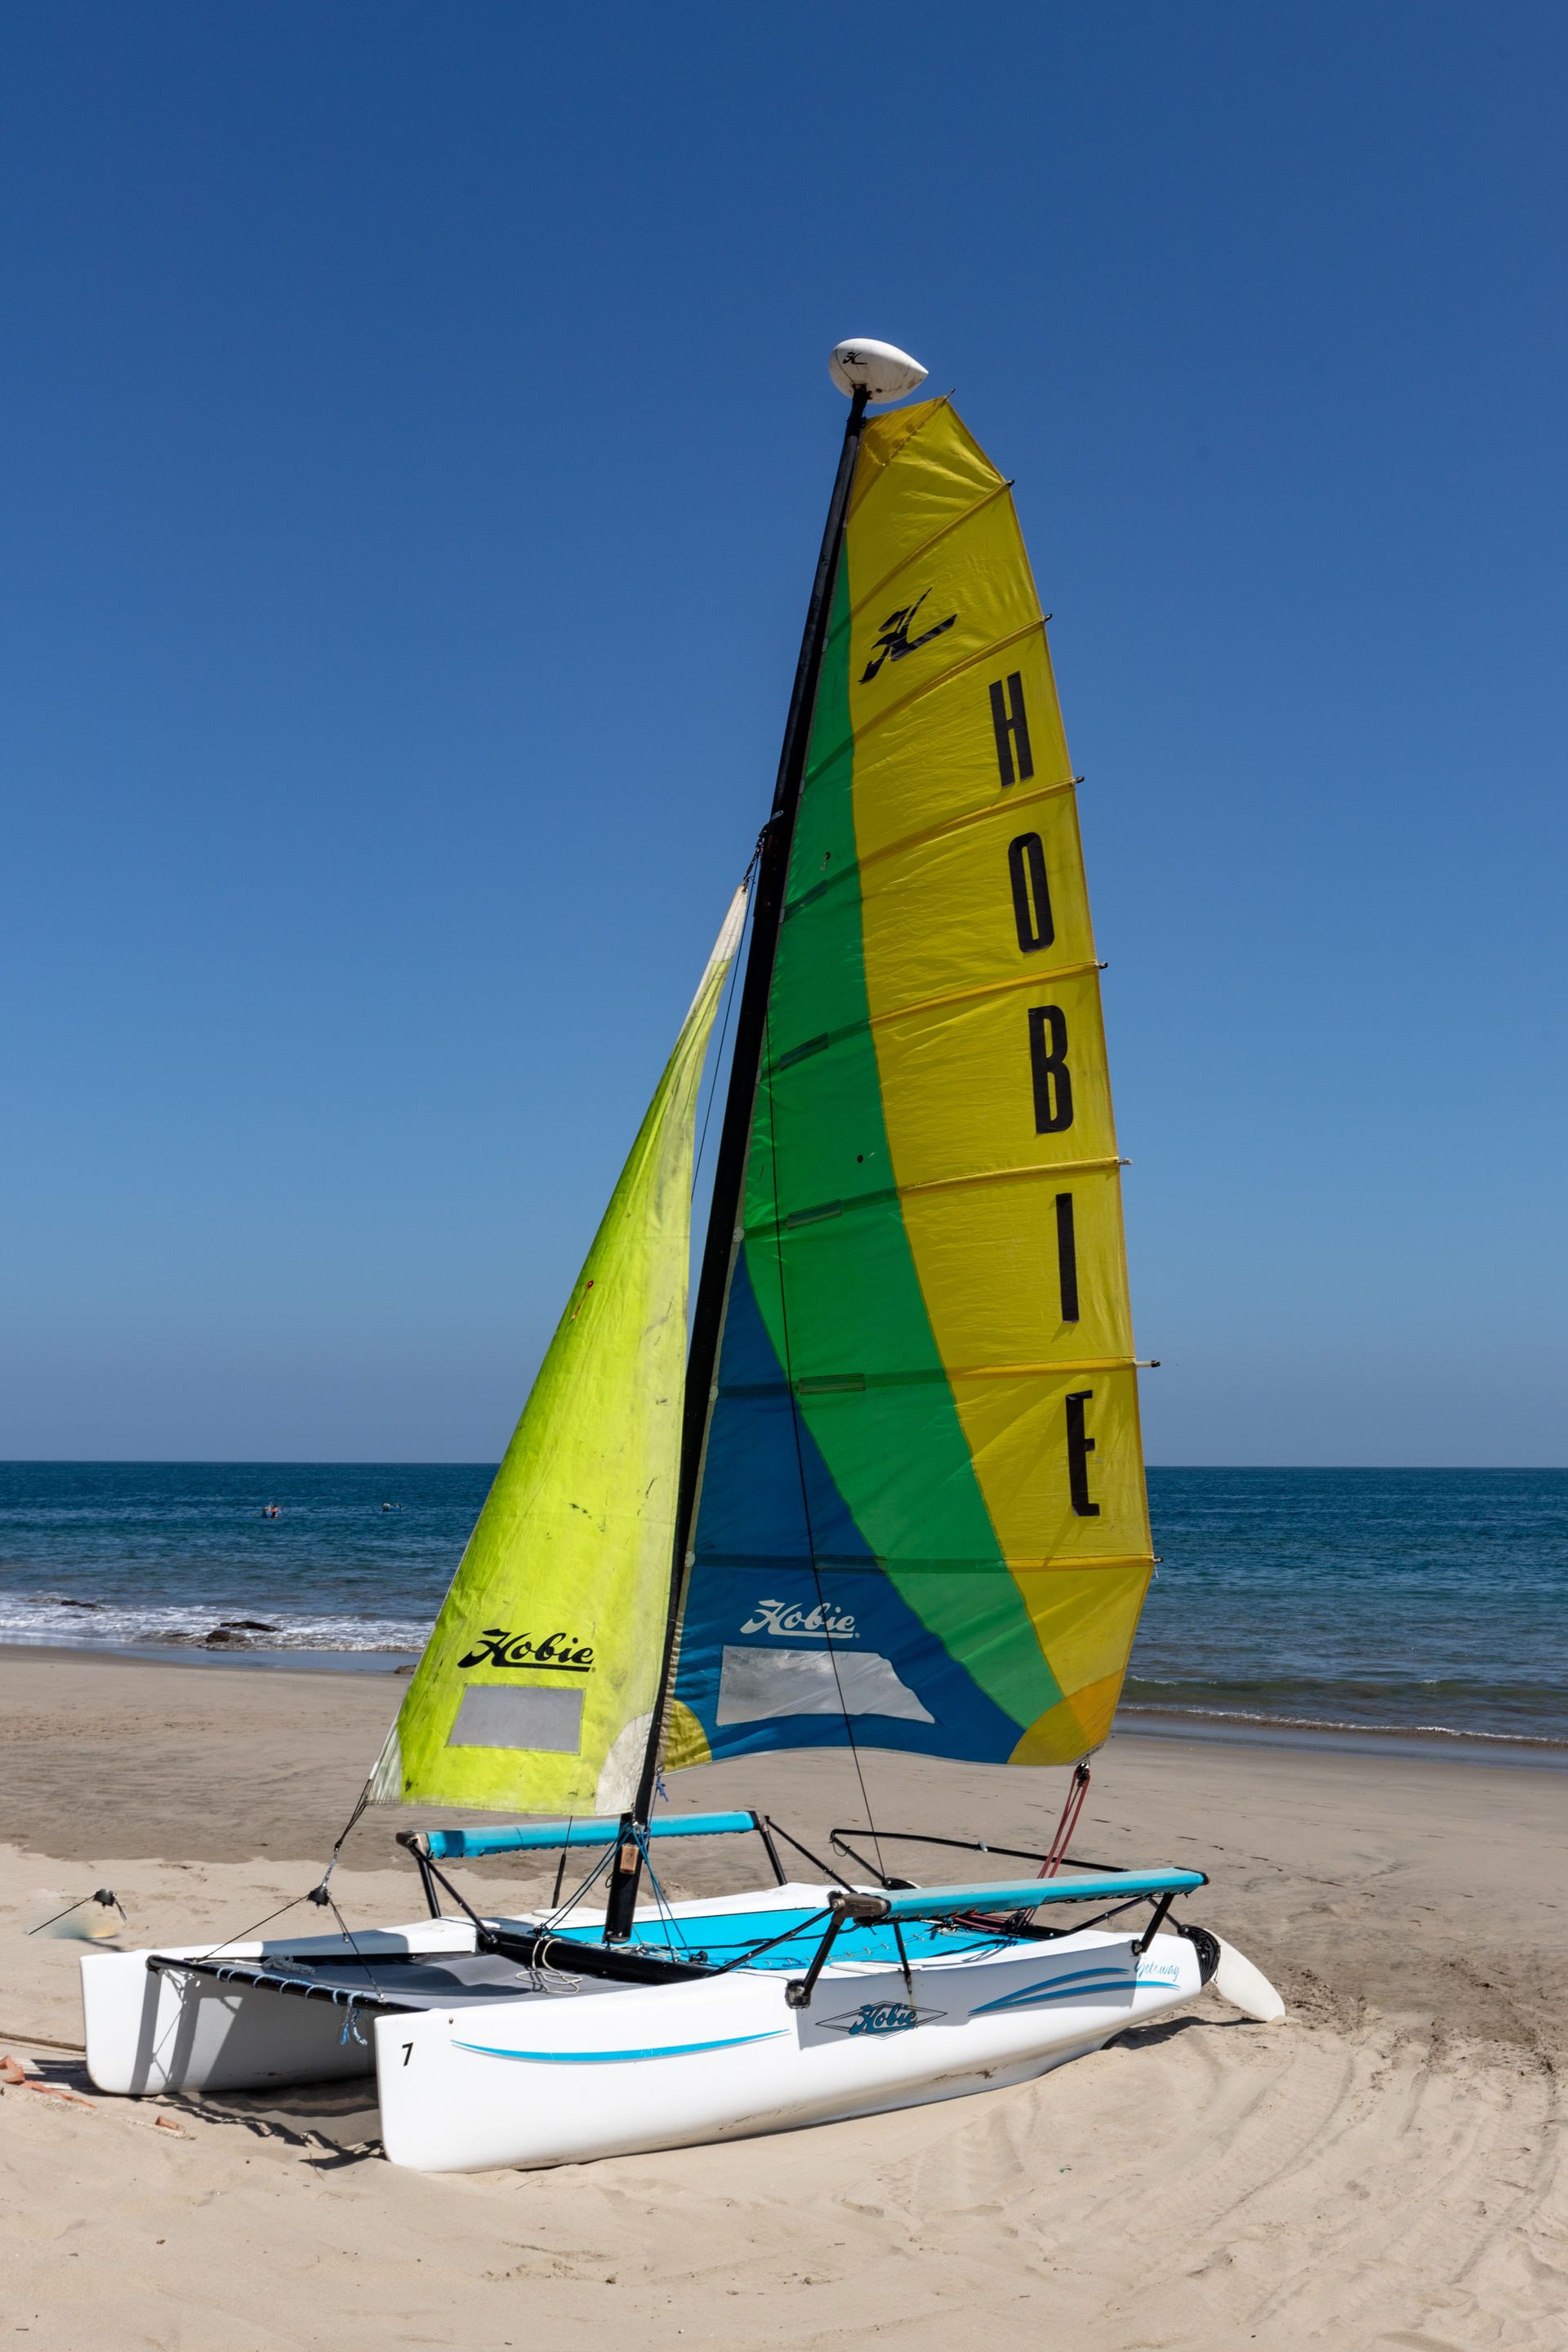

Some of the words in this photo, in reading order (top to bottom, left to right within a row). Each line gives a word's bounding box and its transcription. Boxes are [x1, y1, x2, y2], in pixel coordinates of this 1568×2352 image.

[989, 671, 1100, 1517] HOBIE
[740, 1599, 856, 1638] Hobie
[457, 1628, 595, 1673] Hobie
[849, 2002, 918, 2034] Hobie
[402, 2042, 414, 2066] 7
